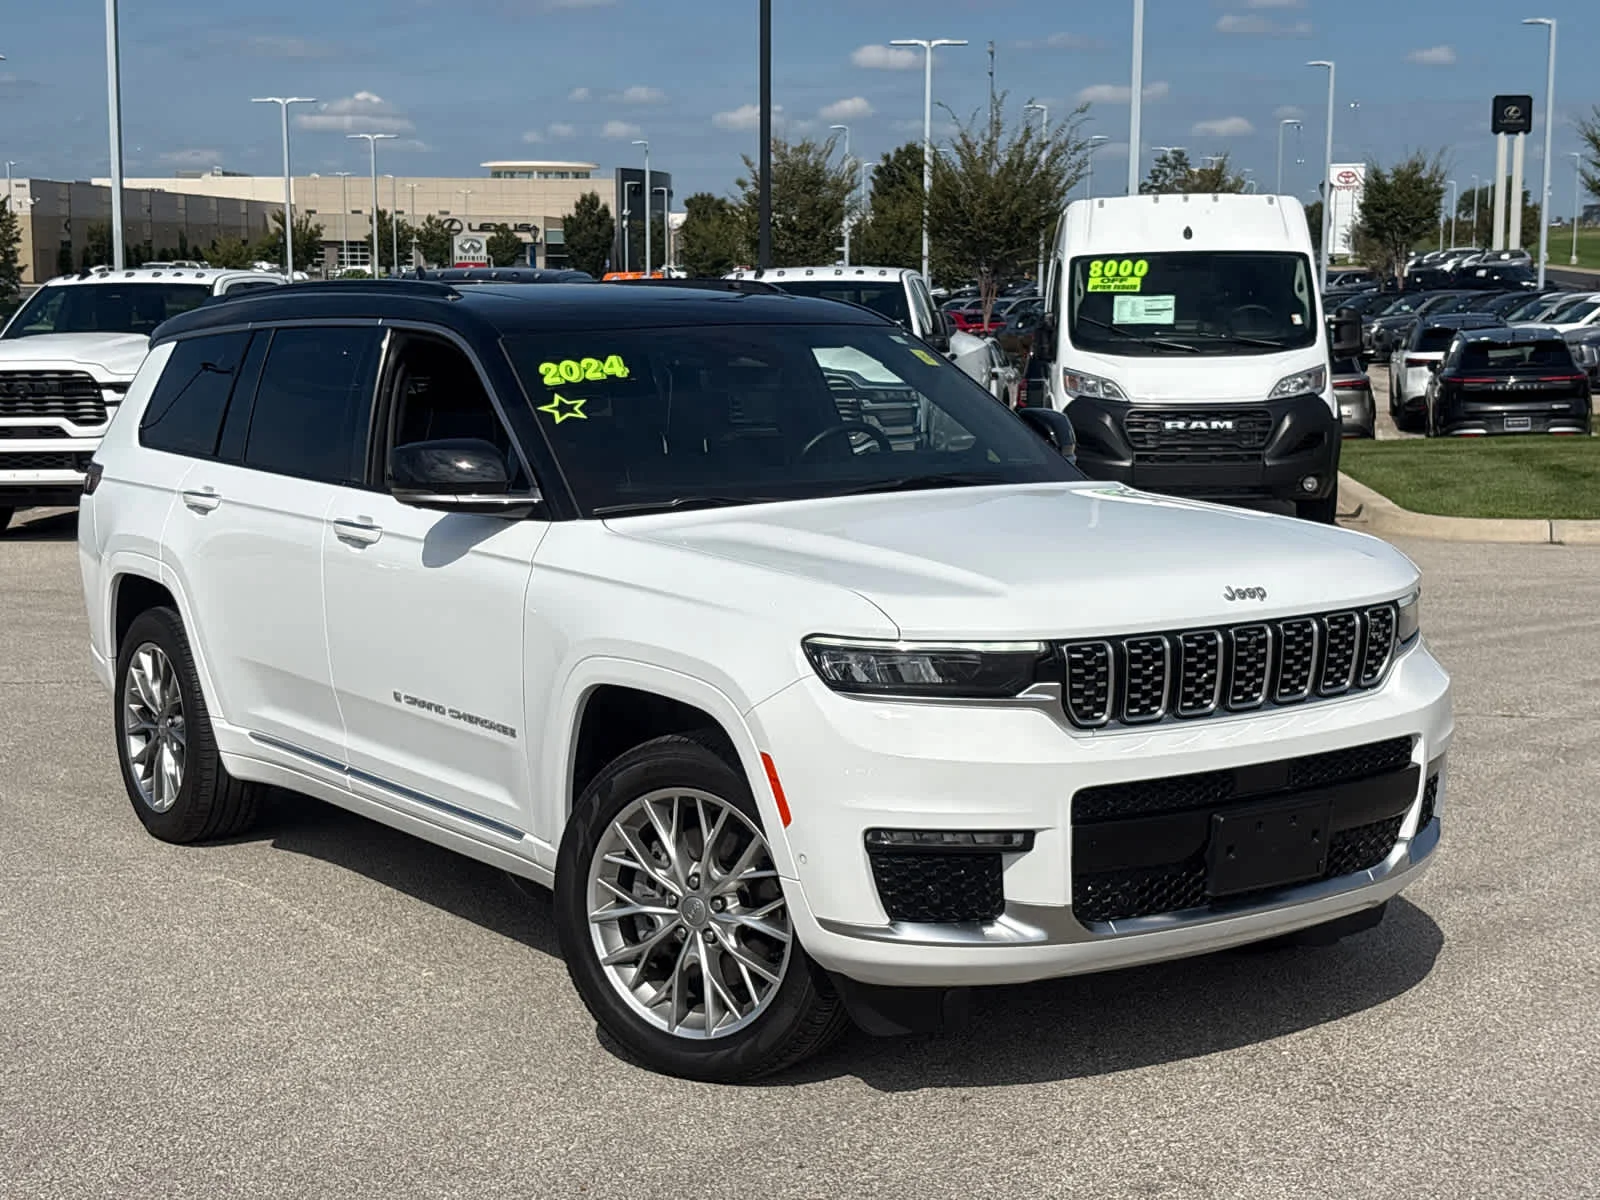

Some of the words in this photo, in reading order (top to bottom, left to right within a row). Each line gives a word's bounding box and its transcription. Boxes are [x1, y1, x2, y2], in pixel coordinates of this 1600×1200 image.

[1089, 259, 1148, 276] 8000
[538, 355, 630, 386] 2024
[1164, 421, 1233, 429] RAM
[1223, 585, 1267, 602] Jeep
[403, 694, 446, 715] GRAND
[447, 707, 517, 739] CHEROKEE
